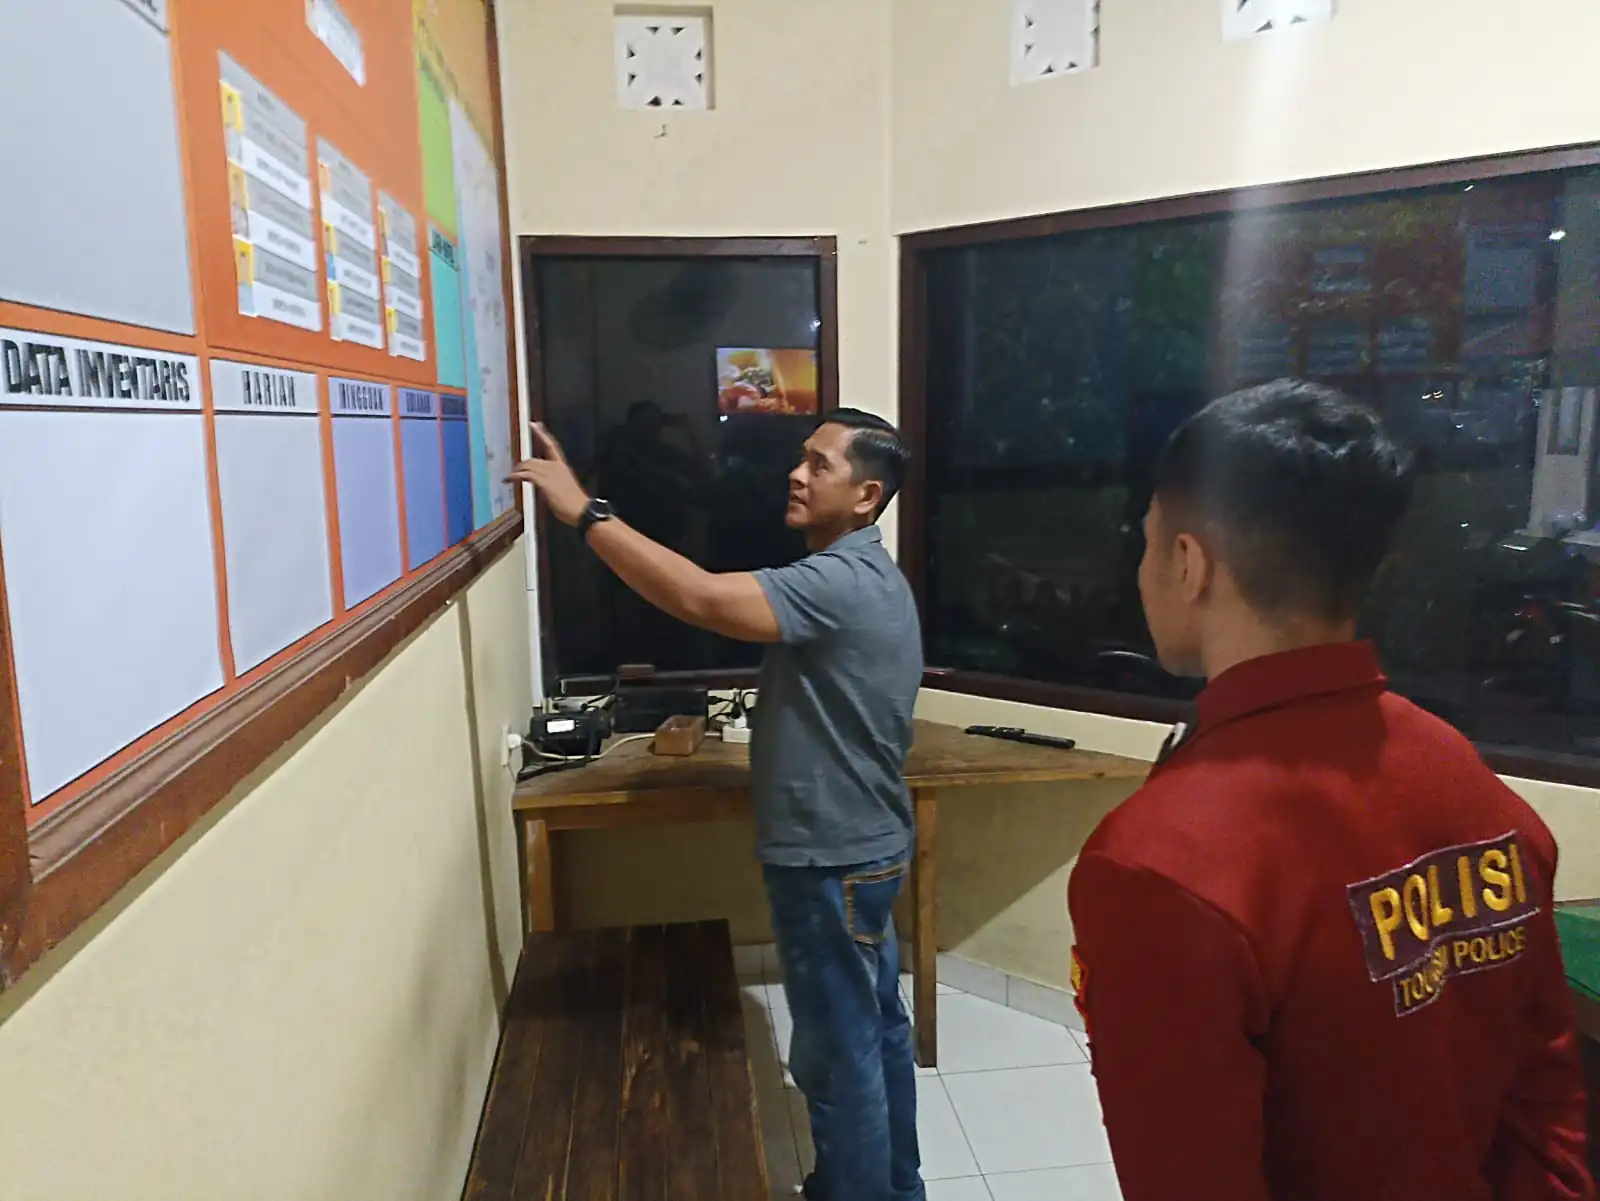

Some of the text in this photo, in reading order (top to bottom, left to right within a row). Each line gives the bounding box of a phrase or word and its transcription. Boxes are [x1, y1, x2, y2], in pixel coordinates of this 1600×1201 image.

[1, 339, 190, 403] DATA INVENTARIS
[242, 370, 296, 407] HARIAN
[1369, 843, 1527, 961] POLISI
[1453, 926, 1526, 969] POLICE
